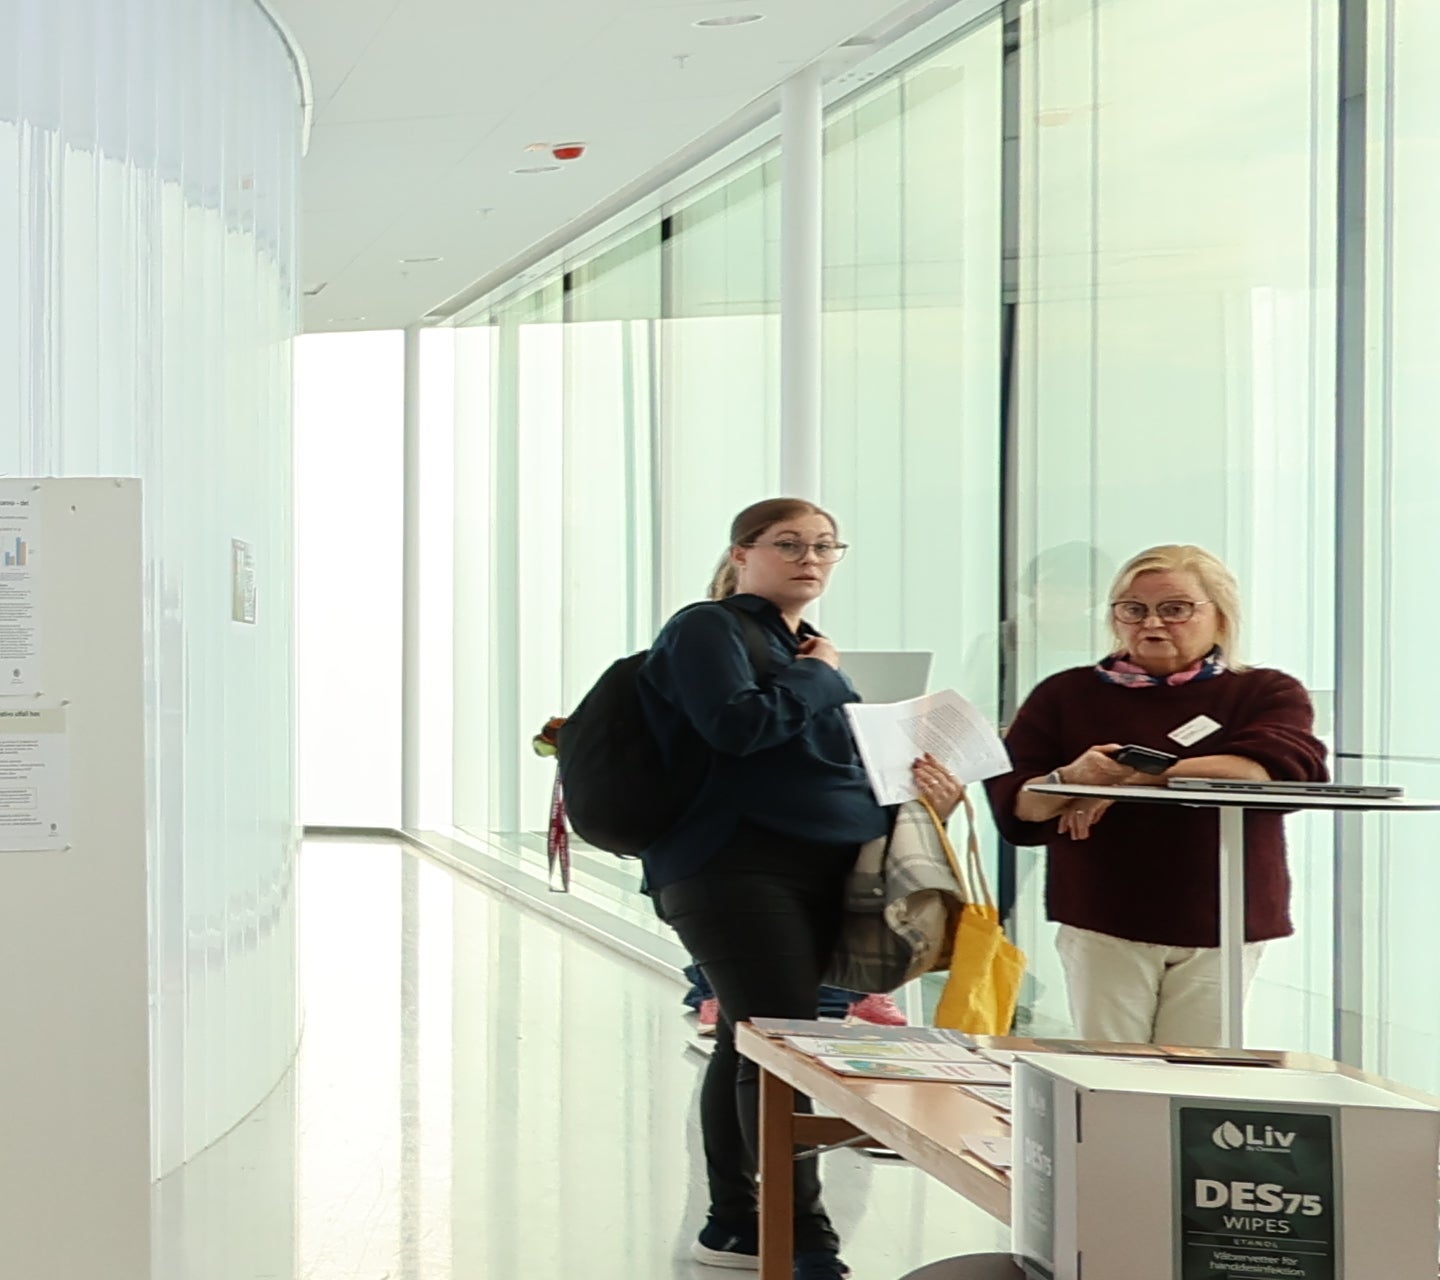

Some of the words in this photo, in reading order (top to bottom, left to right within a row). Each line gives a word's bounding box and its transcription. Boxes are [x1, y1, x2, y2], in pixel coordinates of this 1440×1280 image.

[1245, 1124, 1297, 1148] Liv
[1195, 1178, 1323, 1216] DES75
[1223, 1215, 1291, 1234] WIPES
